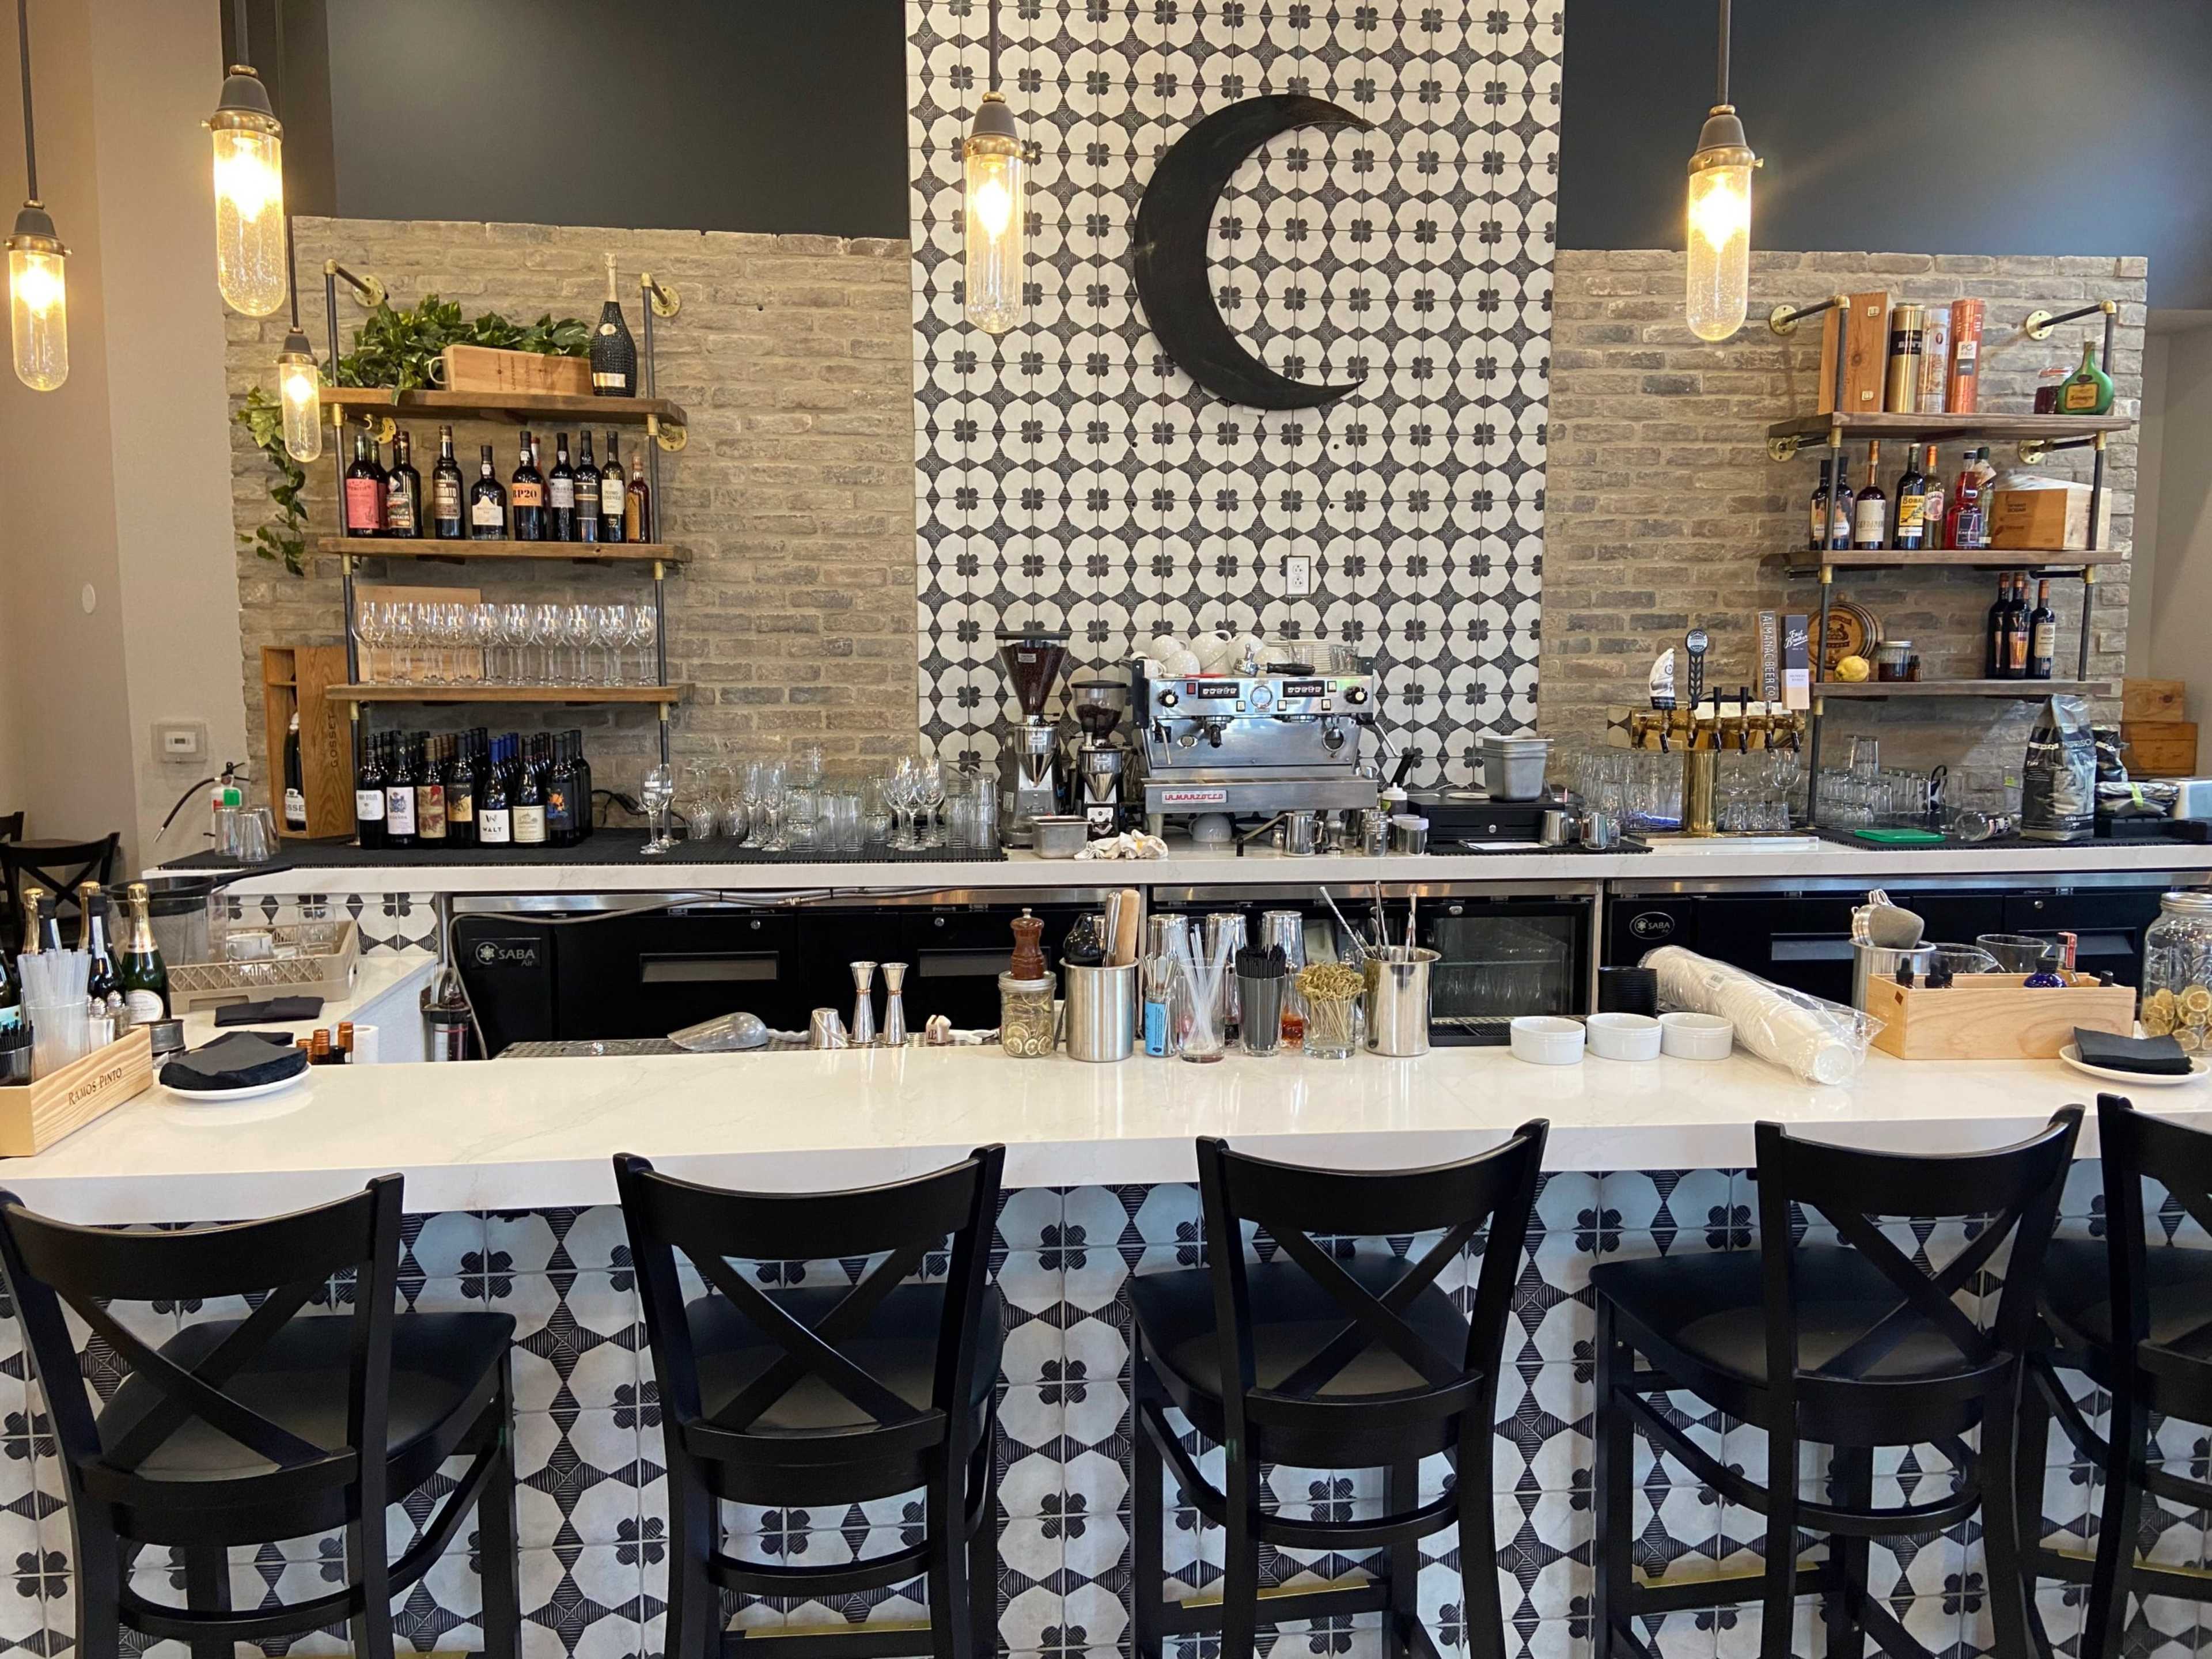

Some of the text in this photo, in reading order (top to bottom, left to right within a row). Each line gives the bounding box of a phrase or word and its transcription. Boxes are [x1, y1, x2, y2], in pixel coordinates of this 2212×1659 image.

[513, 490, 537, 498] RP20
[1762, 616, 1775, 658] ALMANAC
[1764, 661, 1775, 684] BEER
[328, 713, 338, 768] GOSSET
[1648, 922, 1671, 930] SABA
[498, 949, 535, 960] SABA
[69, 1067, 122, 1106] RAMOS PINTO
